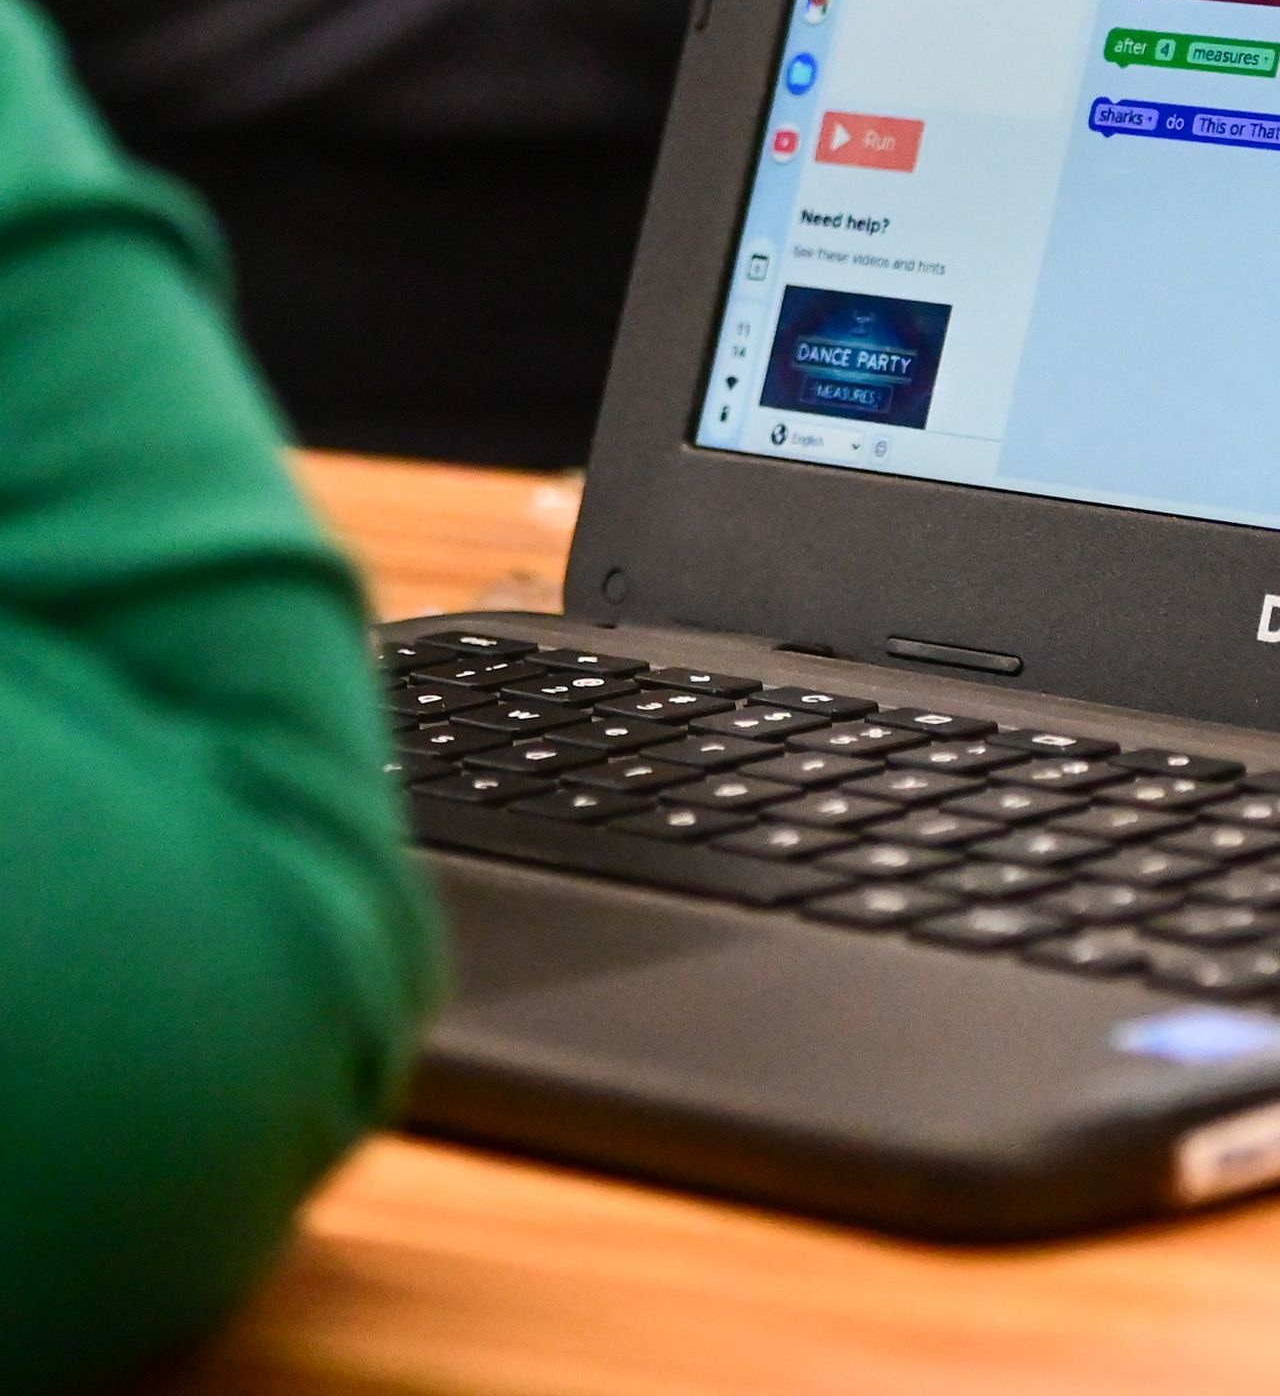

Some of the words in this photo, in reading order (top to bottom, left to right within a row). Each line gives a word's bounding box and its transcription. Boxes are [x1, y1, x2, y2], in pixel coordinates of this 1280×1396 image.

[1113, 37, 1148, 56] after
[1159, 41, 1170, 58] 4
[1192, 46, 1260, 67] measures
[1098, 107, 1144, 127] sharks
[1165, 114, 1186, 132] do
[1197, 117, 1226, 135] This
[1229, 122, 1248, 137] or
[862, 131, 897, 153] Run
[800, 208, 844, 229] Need
[847, 213, 891, 237] help?
[852, 252, 890, 270] videos
[892, 256, 916, 273] and
[918, 259, 947, 277] hints
[797, 341, 853, 368] DANCE
[856, 349, 913, 376] PARTY
